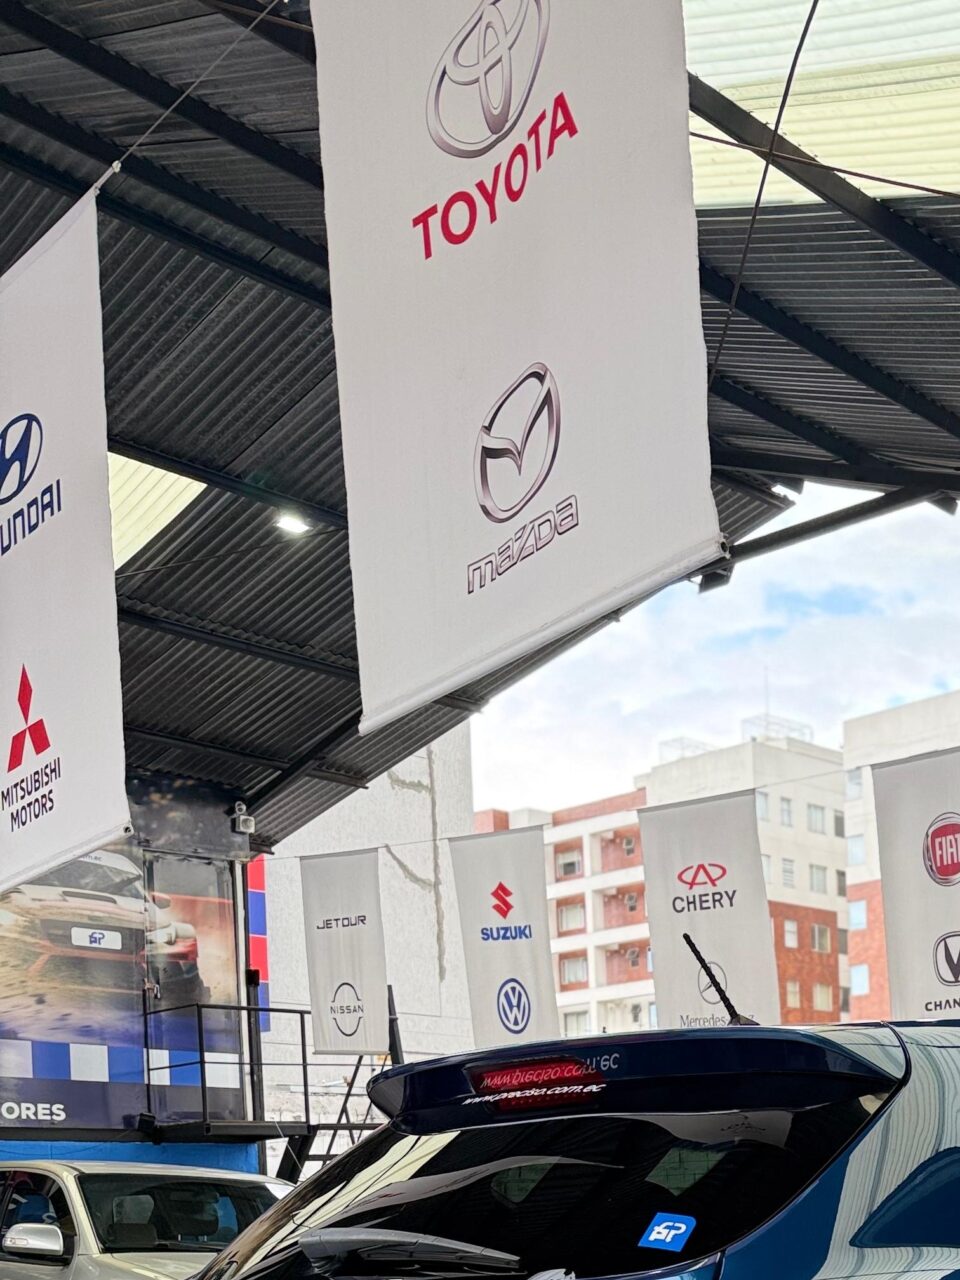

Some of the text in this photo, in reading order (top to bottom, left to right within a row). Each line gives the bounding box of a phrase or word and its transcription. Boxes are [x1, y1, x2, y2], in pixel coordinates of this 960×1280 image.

[412, 91, 579, 260] TOYOTA
[1, 756, 61, 811] MITSUBISHI
[10, 789, 55, 832] MOTORS
[672, 889, 738, 914] CHERY
[316, 915, 367, 930] JETOUR
[480, 924, 533, 942] SUZUKI
[330, 1004, 365, 1015] NISSAN
[1, 1101, 67, 1121] ORES
